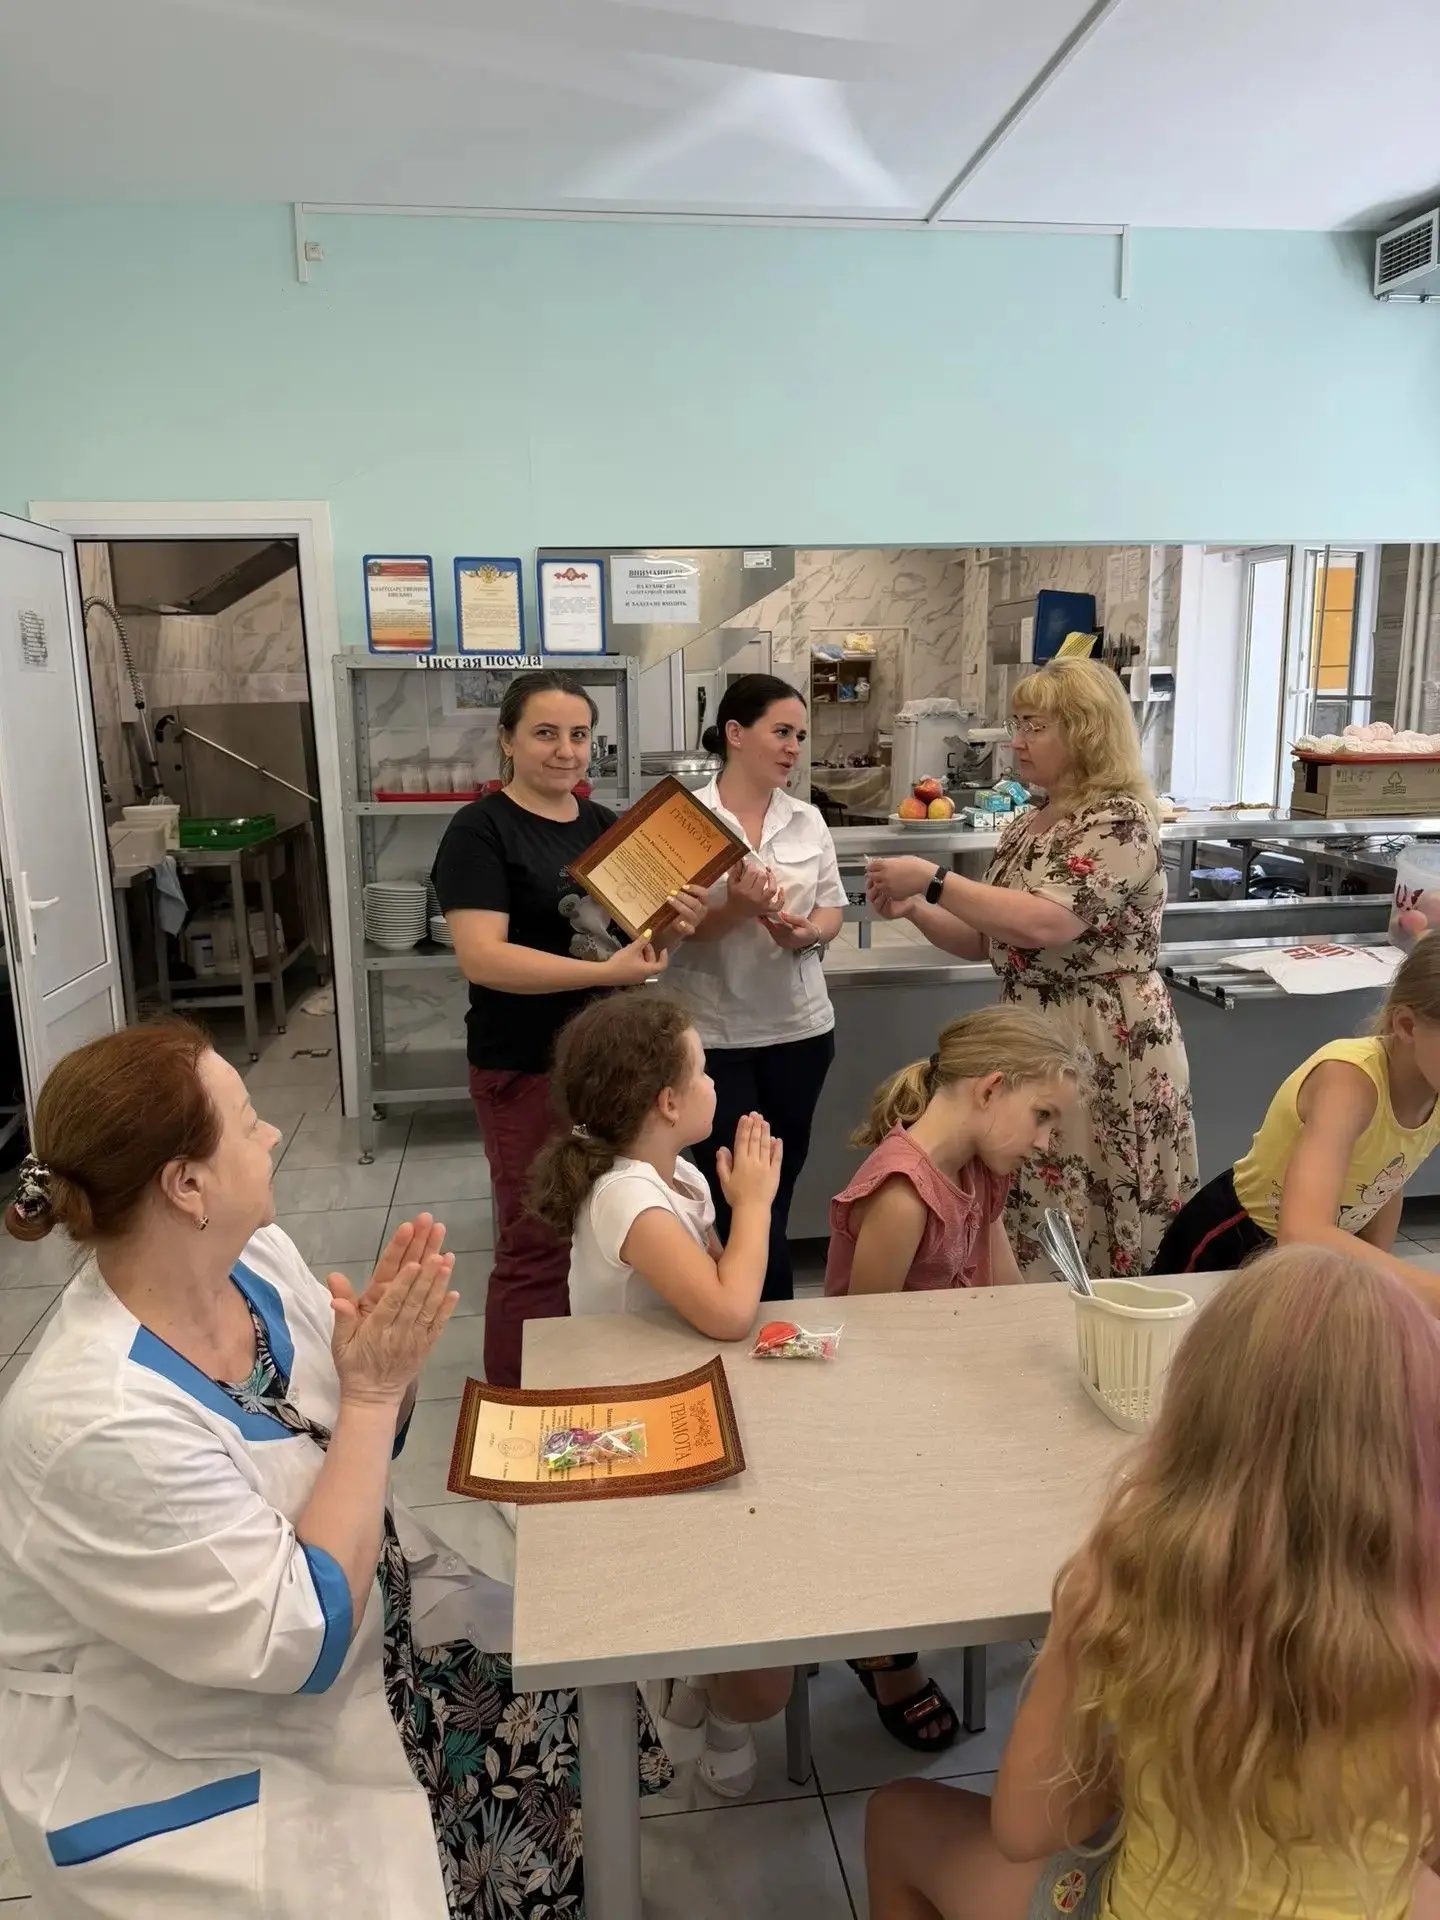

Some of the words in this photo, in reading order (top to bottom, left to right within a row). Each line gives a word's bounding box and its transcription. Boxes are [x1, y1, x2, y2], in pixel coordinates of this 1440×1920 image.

[418, 655, 482, 669] Чистая
[485, 655, 543, 669] посуда
[669, 807, 712, 853] ГРАМОТА
[670, 1402, 691, 1461] ГРАМОТА
